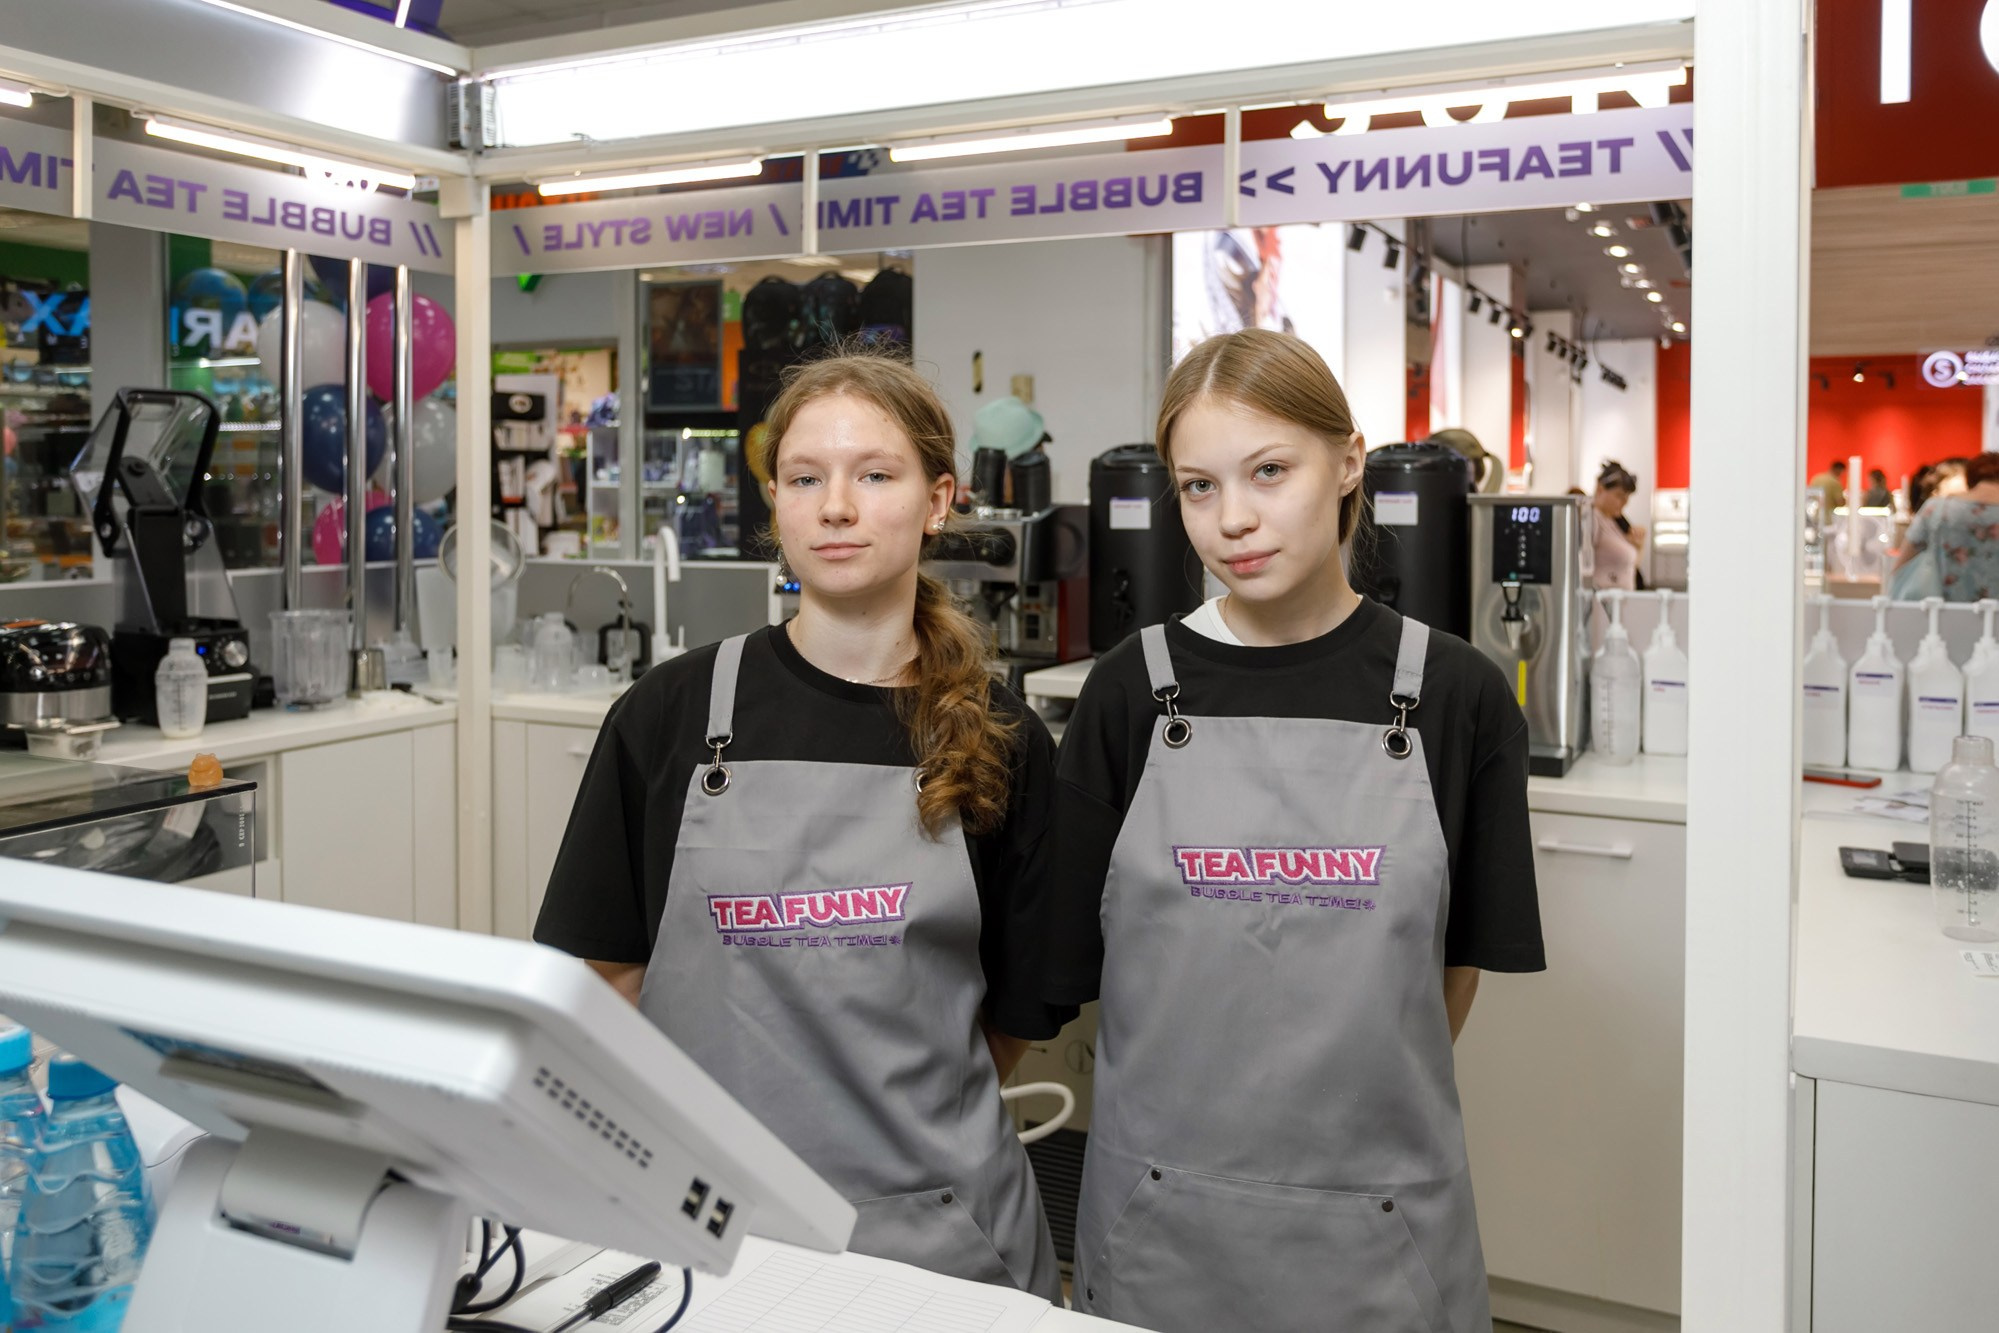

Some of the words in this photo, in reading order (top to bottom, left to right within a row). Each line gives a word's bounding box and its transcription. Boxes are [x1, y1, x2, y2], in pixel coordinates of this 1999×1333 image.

[1511, 506, 1541, 523] 100
[1191, 885, 1263, 902] BUBBLE
[1265, 891, 1303, 906] TEA
[722, 934, 792, 948] BUBBLE
[794, 936, 832, 948] TEA
